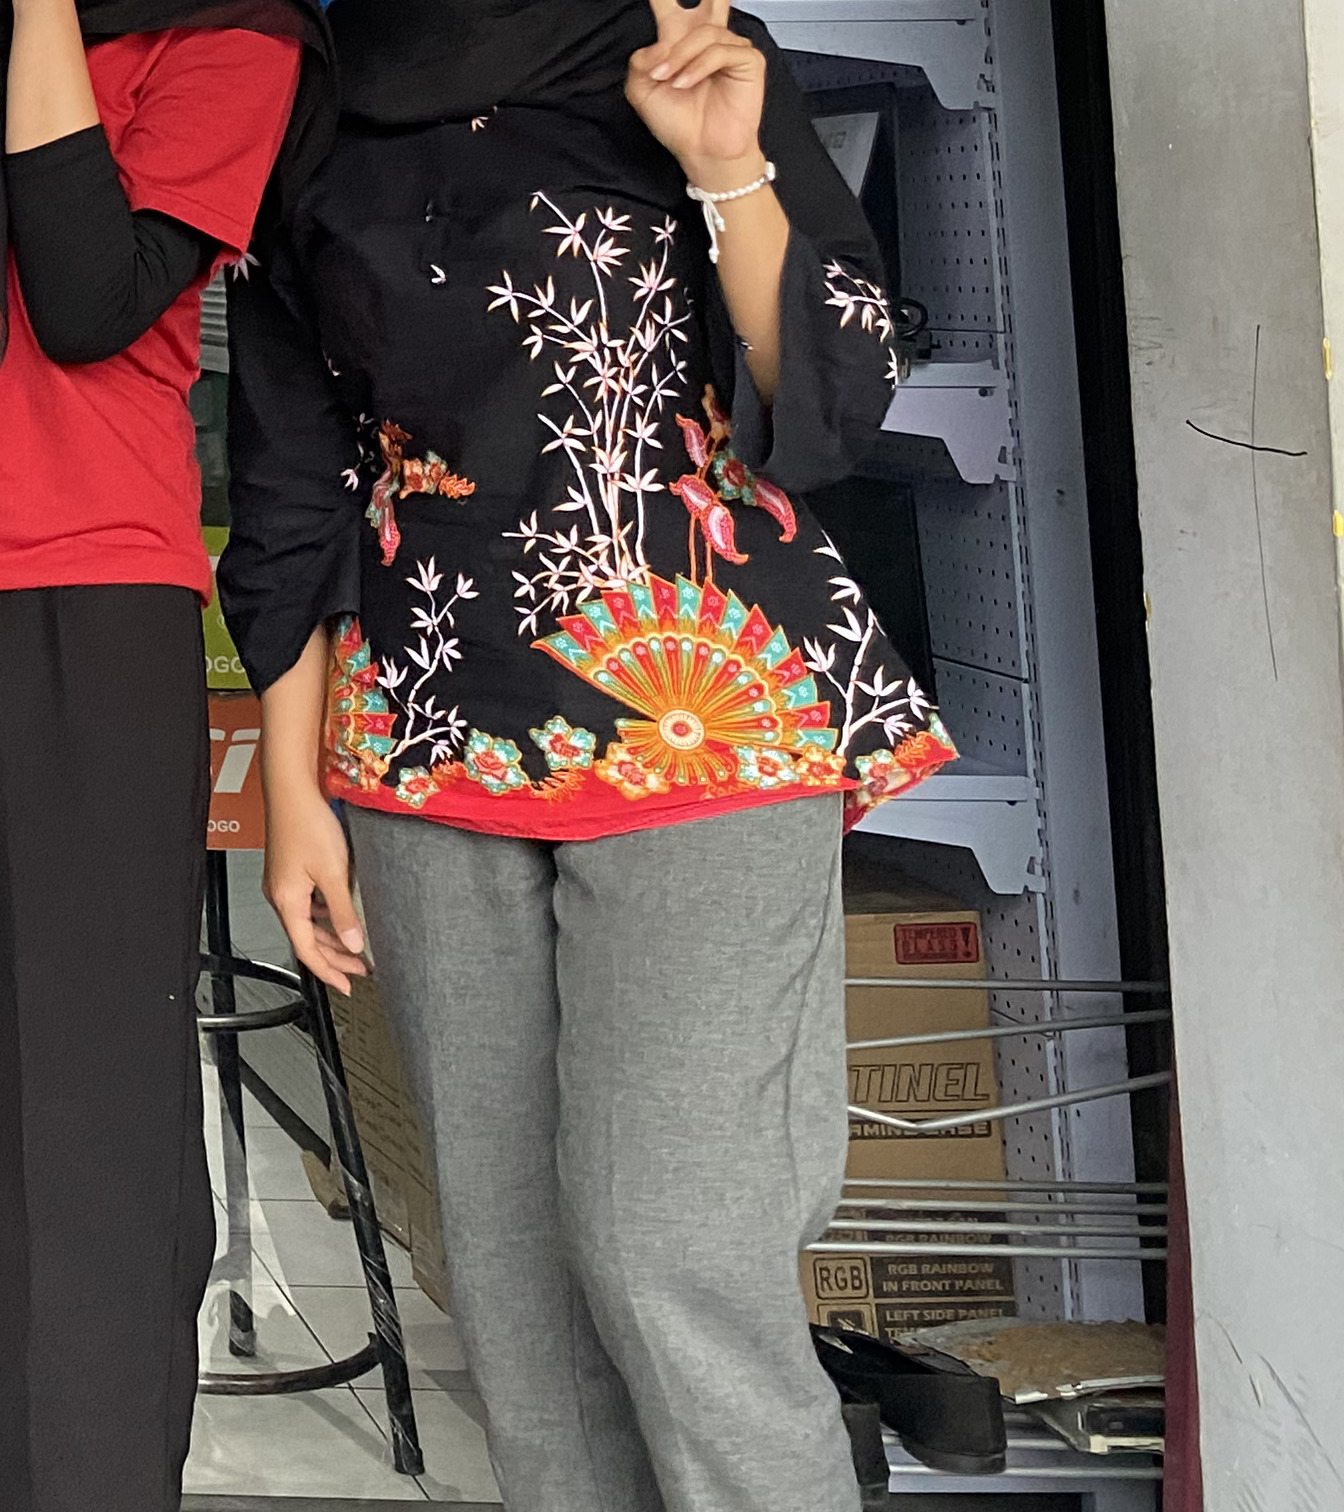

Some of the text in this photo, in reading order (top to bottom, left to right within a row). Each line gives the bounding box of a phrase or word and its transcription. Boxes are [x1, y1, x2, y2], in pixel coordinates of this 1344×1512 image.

[849, 1061, 990, 1104] TINEL
[888, 1262, 994, 1275] RGB RAINBOW
[819, 1265, 864, 1292] RGB
[883, 1279, 1004, 1292] IN FRONT PANEL
[886, 1310, 920, 1321] LEFT
[924, 1309, 955, 1320] SIDE
